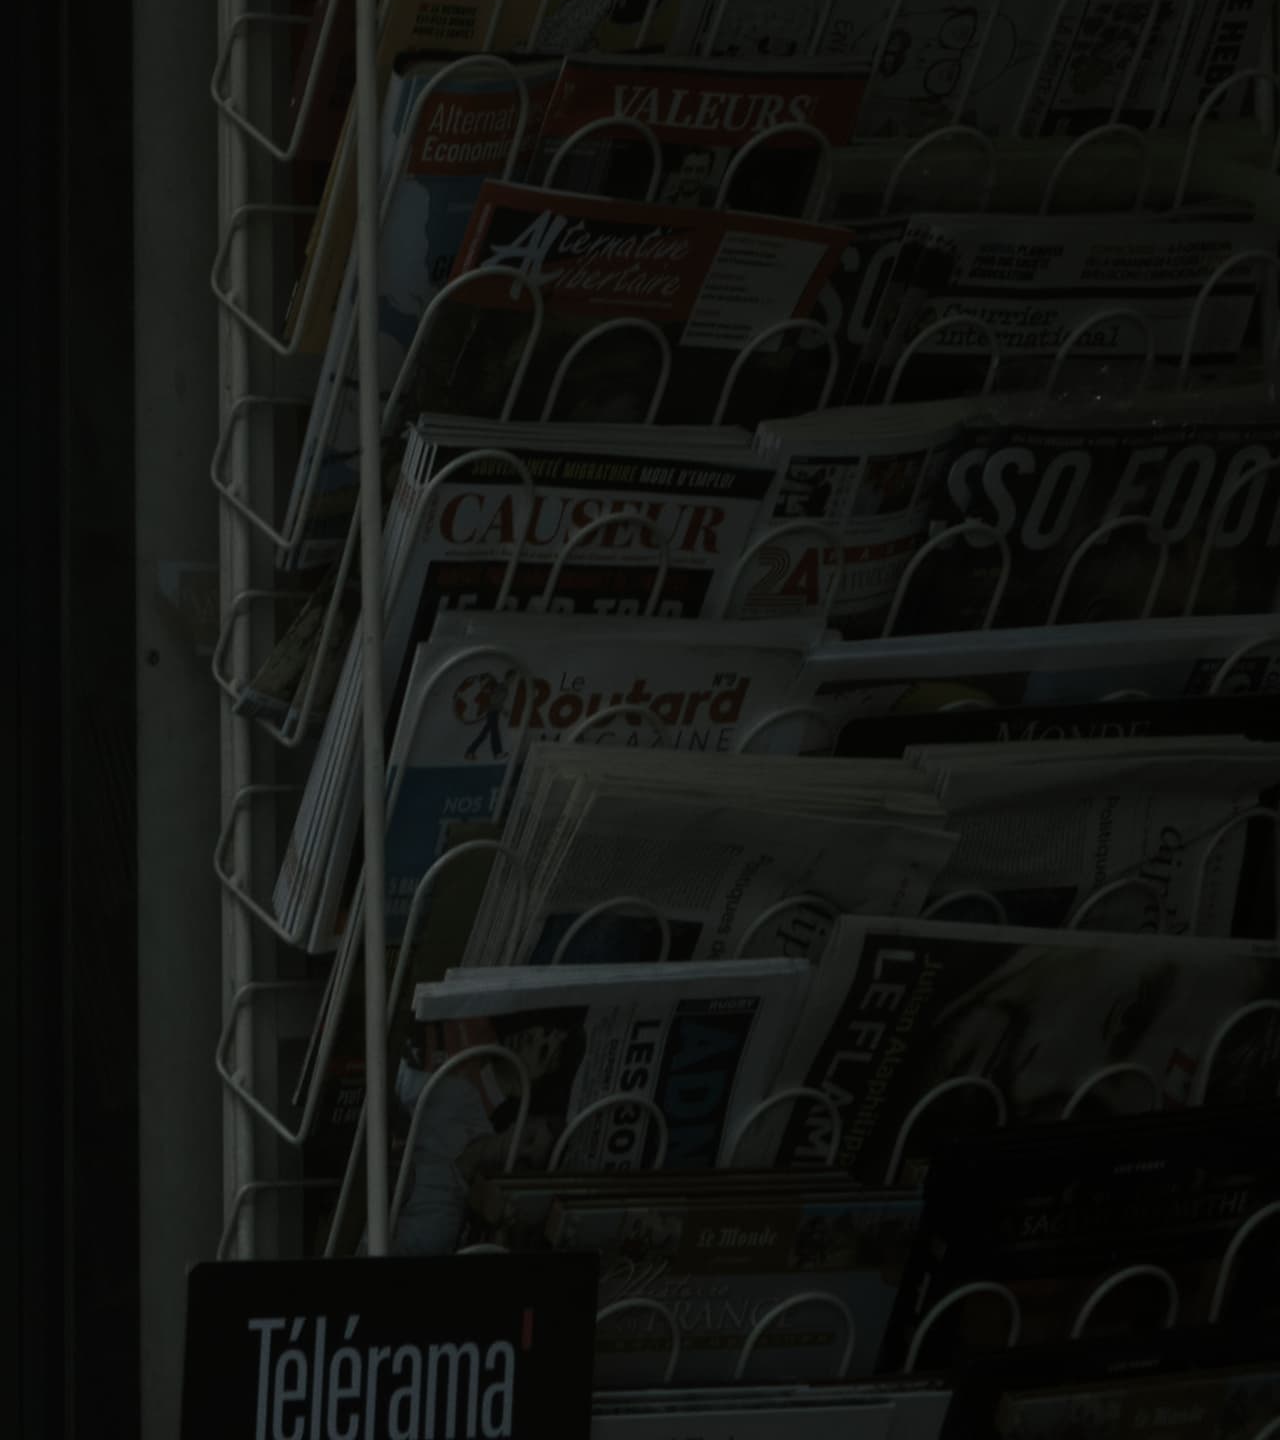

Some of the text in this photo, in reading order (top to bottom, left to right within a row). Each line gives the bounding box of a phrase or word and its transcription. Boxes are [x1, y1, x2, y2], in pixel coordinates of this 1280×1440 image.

[611, 84, 813, 134] VALEURS
[560, 460, 639, 485] MIGRATOIRE
[639, 466, 676, 487] MODE
[676, 467, 737, 490] D'EMPLOI
[439, 491, 726, 556] CAUSEUR
[507, 675, 752, 728] Routard
[559, 671, 586, 693] Le
[442, 794, 482, 815] NOS
[861, 948, 916, 1010] LE
[606, 1019, 661, 1154] LES 30
[696, 1227, 778, 1249] Le Monde
[247, 1312, 518, 1440] Télérama
